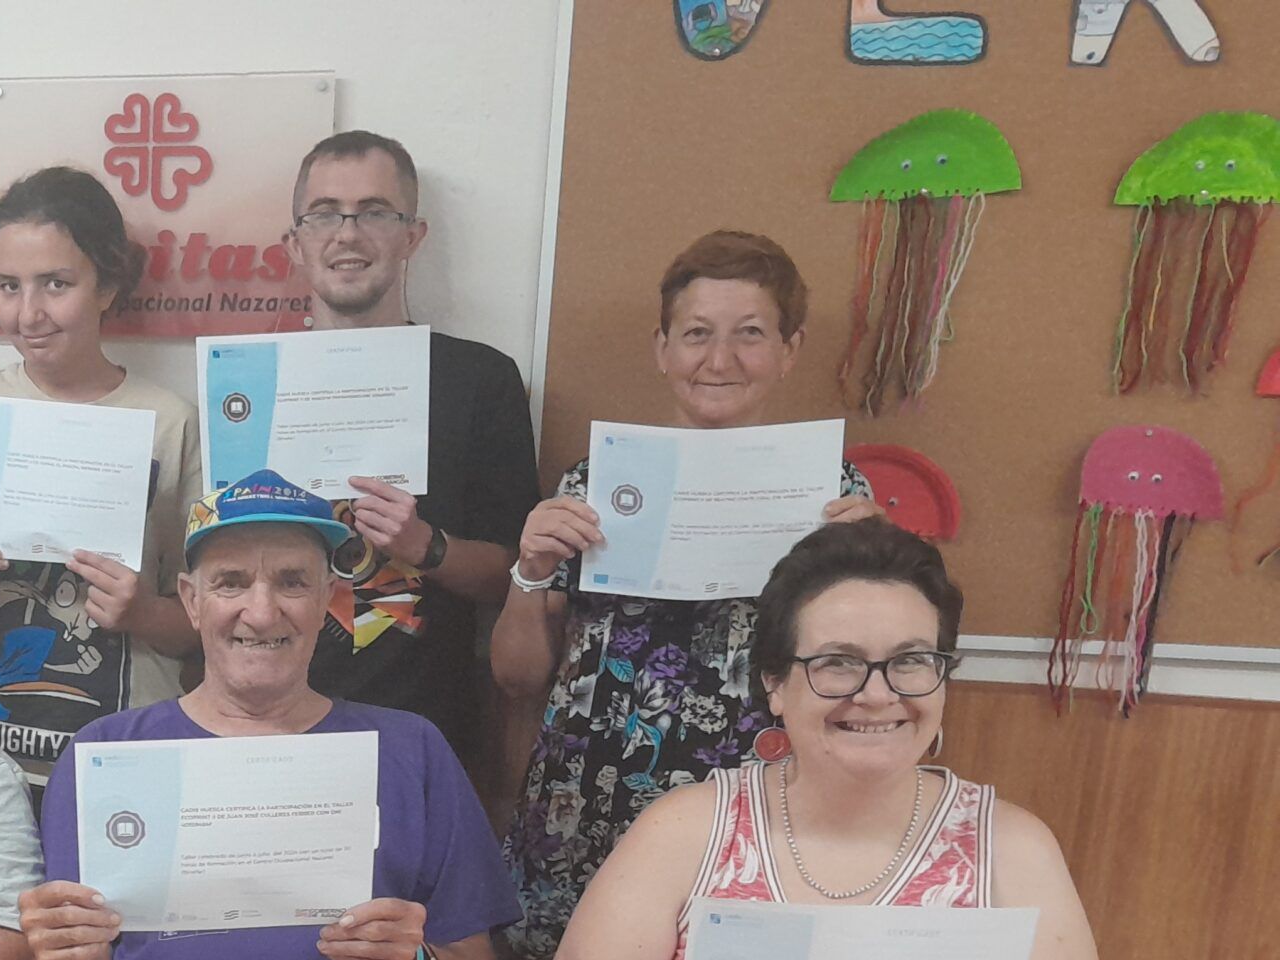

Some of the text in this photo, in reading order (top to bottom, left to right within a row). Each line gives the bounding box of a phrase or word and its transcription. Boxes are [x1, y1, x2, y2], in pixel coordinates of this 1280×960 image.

[148, 229, 295, 281] itas
[116, 292, 312, 318] pacional Nazaret
